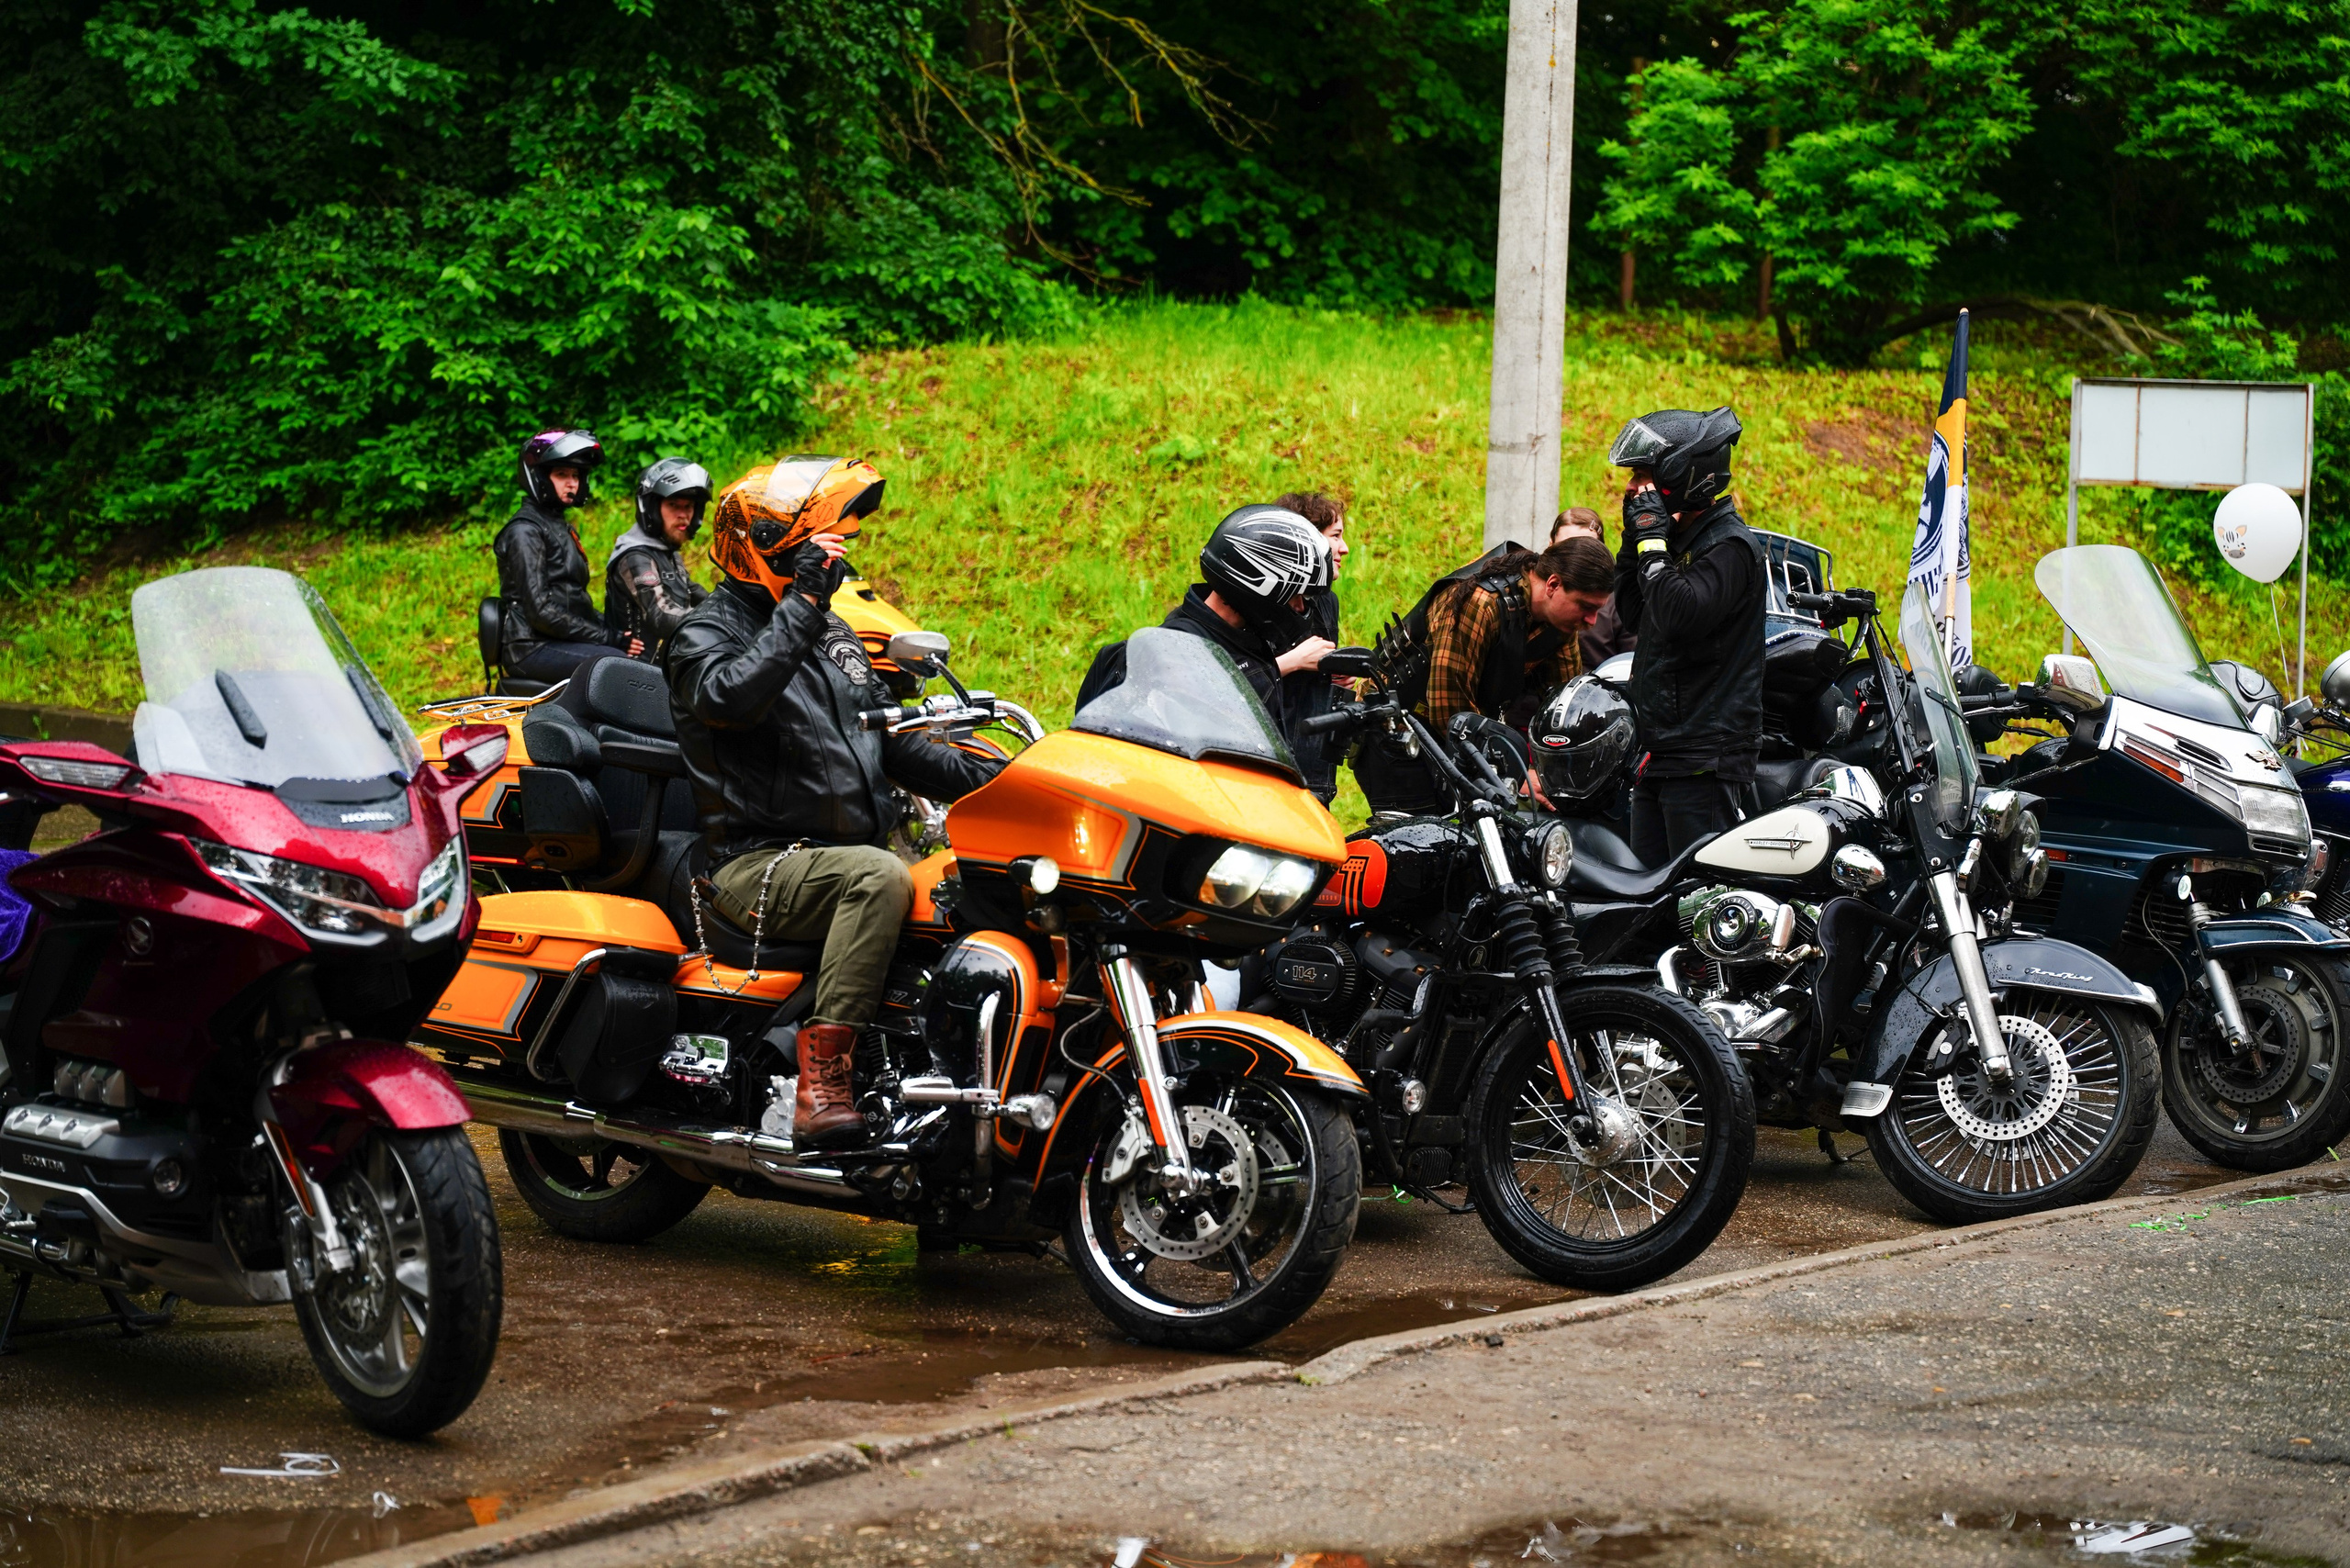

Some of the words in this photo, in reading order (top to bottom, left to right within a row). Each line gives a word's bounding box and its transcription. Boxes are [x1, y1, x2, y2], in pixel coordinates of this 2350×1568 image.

[1237, 661, 1249, 670] rey
[340, 812, 395, 823] HONDA
[1292, 965, 1317, 980] 114
[22, 1153, 66, 1173] HONDA
